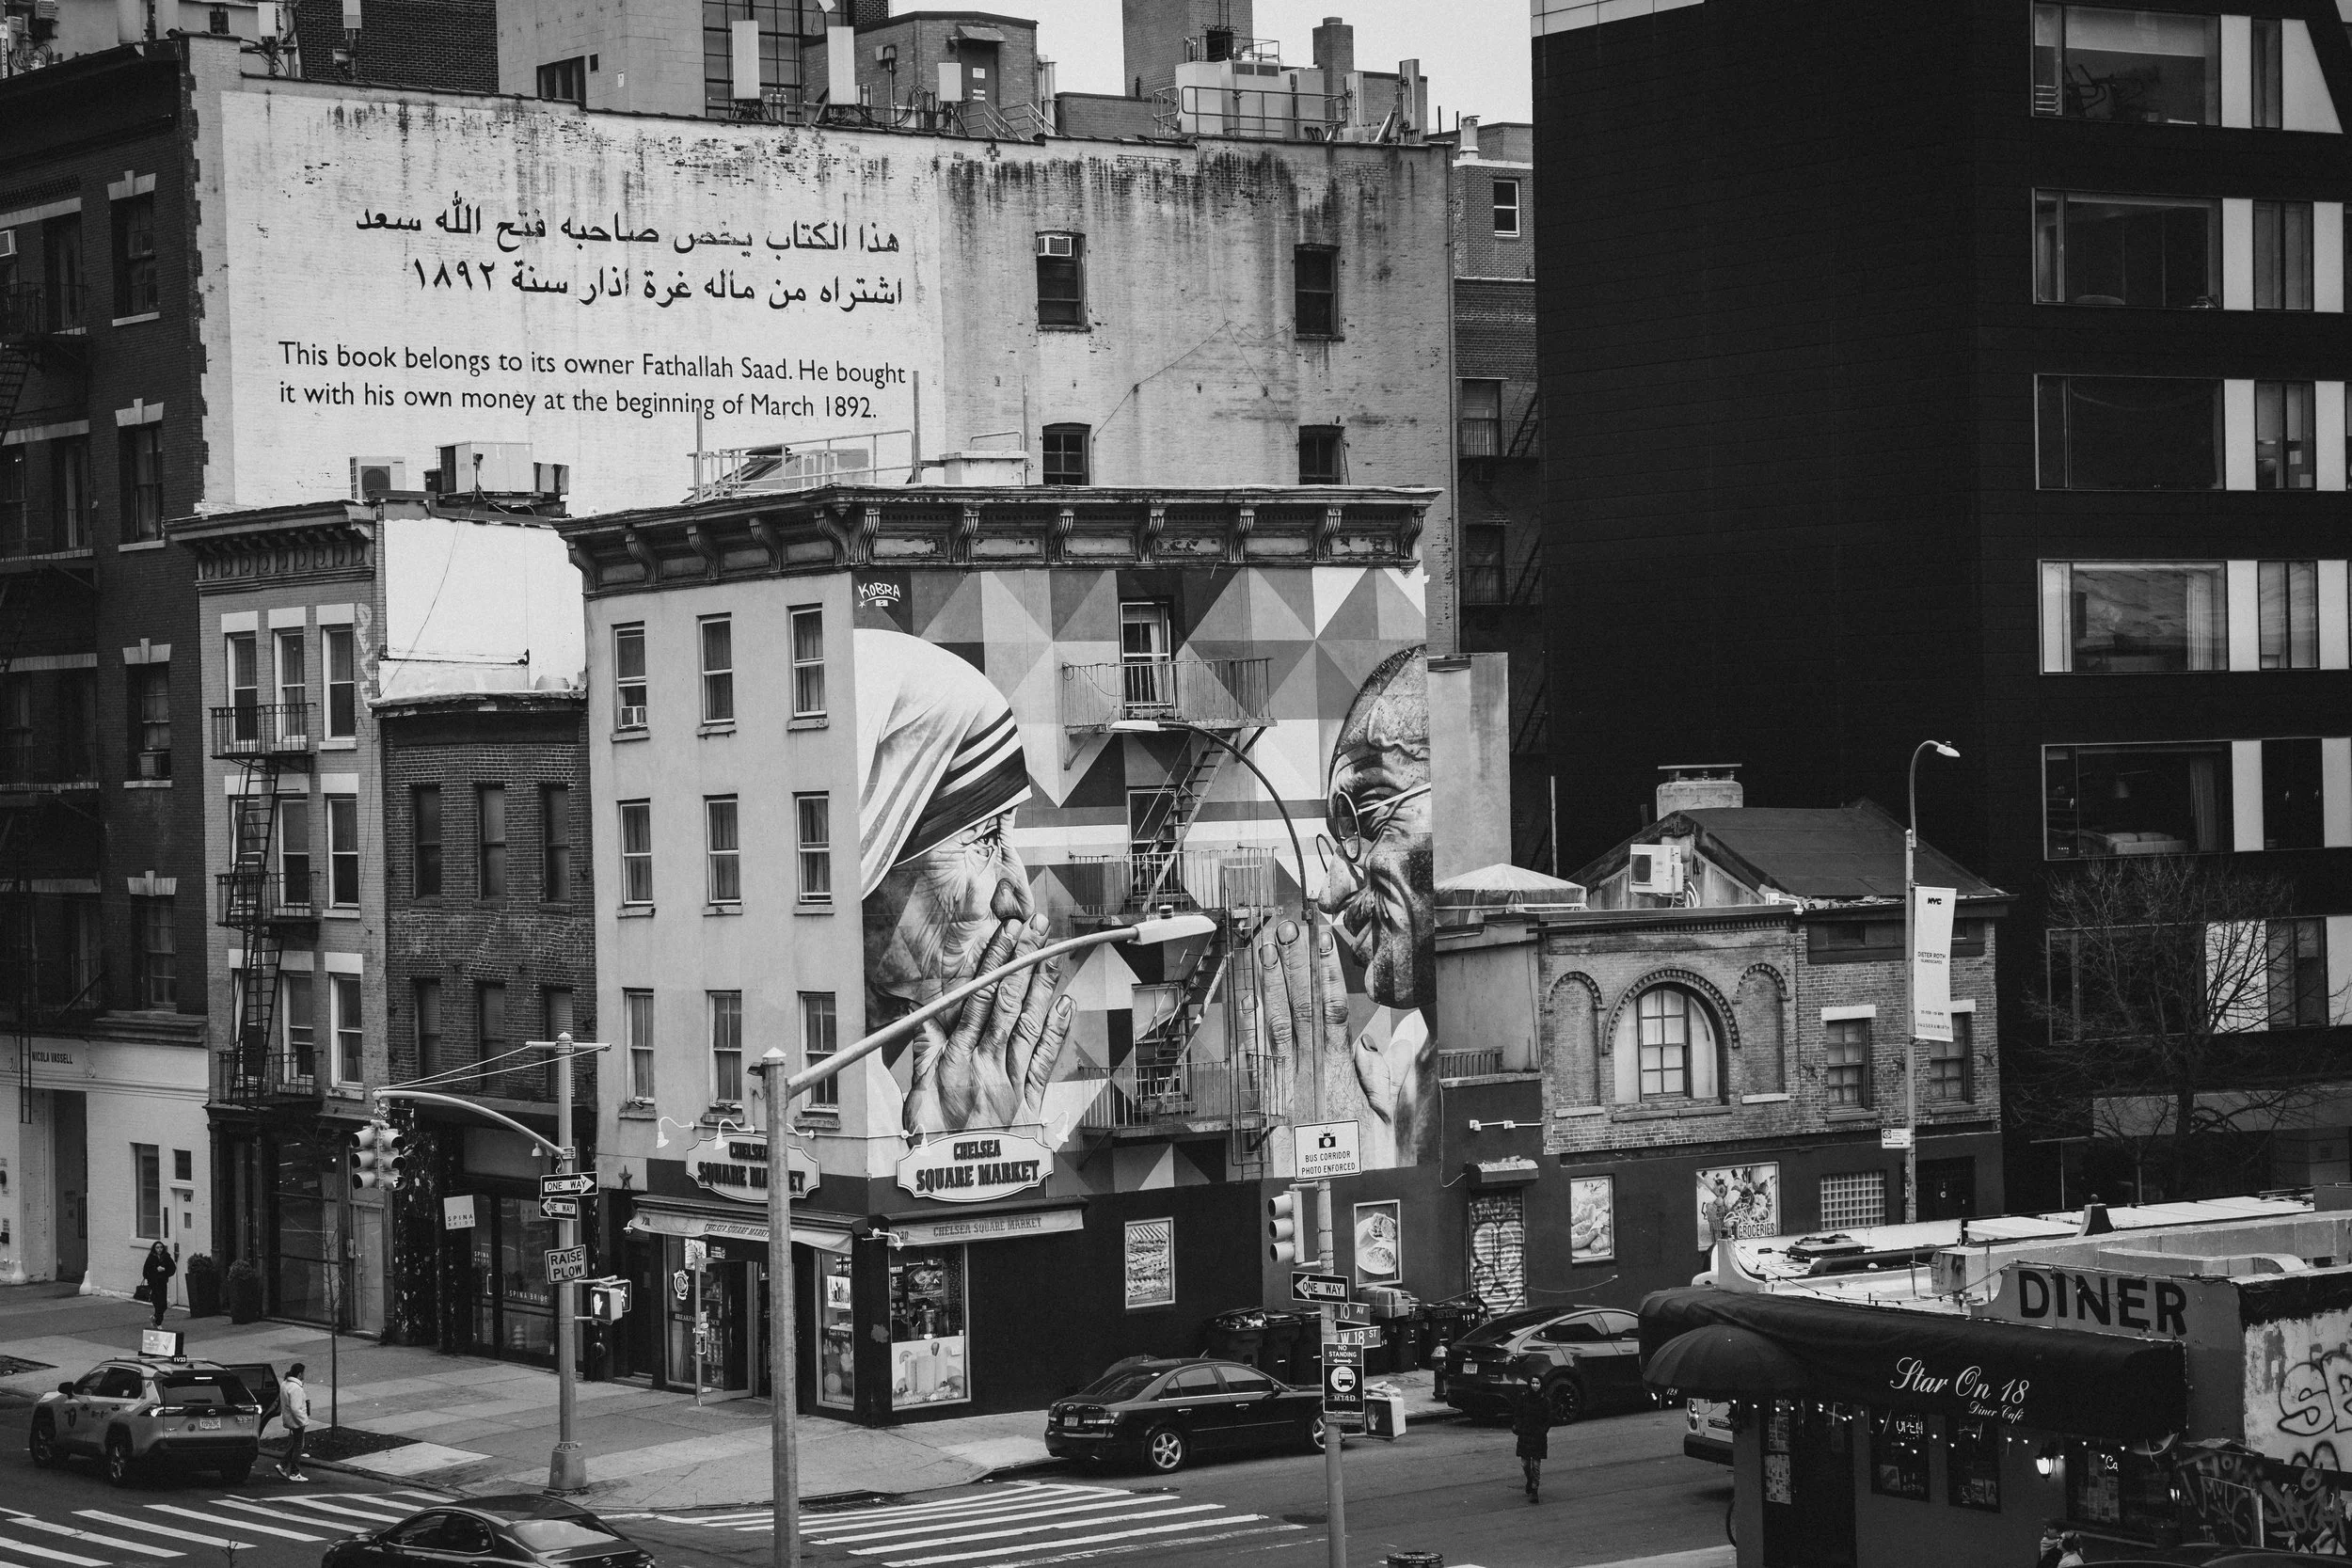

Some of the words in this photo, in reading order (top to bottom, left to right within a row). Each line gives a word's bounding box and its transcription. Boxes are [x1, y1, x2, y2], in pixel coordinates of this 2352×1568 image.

[357, 209, 421, 231] سعد
[497, 209, 547, 252] فتح
[561, 212, 660, 250] صاحبه
[766, 219, 847, 261] الكتاب
[860, 222, 899, 252] هذا
[413, 258, 495, 291] ١٨٩٢
[512, 260, 568, 294] سنة
[579, 265, 628, 305] اذار
[704, 269, 755, 299] ماله
[644, 270, 692, 308] غرة
[769, 279, 807, 309] من
[819, 276, 901, 312] اشتراه
[278, 341, 328, 366] This
[337, 343, 397, 368] book
[405, 346, 490, 376] belongs
[499, 354, 523, 372] to
[531, 351, 556, 372] its
[564, 357, 635, 374] owner
[643, 353, 734, 377] Fathallah
[741, 356, 793, 380] Saad.
[799, 358, 829, 381] He
[836, 360, 906, 389] bought
[279, 381, 296, 404] it
[304, 382, 354, 405] with
[365, 383, 394, 406] his
[404, 390, 453, 407] own
[462, 391, 536, 416] money
[544, 391, 565, 410] at
[573, 388, 608, 411] the
[616, 390, 715, 420] beginning
[723, 393, 745, 415] of
[752, 393, 814, 417] March
[825, 396, 878, 419] 1892.
[858, 582, 901, 599] KOBRA
[31, 1051, 50, 1063] NICOLA
[51, 1053, 73, 1064] VASSELL
[953, 1139, 1002, 1160] CHELSEA
[1305, 1153, 1318, 1163] BUS
[1319, 1150, 1351, 1162] CORRIDOR
[697, 1161, 747, 1187] SQUARE
[749, 1165, 806, 1193] MAET
[915, 1164, 975, 1193] SQUARE
[977, 1159, 1041, 1187] MARKET
[1301, 1165, 1322, 1175] PHOTO
[1323, 1163, 1356, 1174] ENFORCED
[547, 1181, 563, 1191] ONE
[570, 1180, 587, 1189] WAY
[447, 1213, 474, 1223] SPINA
[546, 1202, 557, 1212] ONE
[562, 1204, 574, 1212] WAY
[705, 1223, 727, 1232] CHELSEA
[727, 1225, 749, 1235] SQUARE
[749, 1227, 770, 1237] MARKE
[933, 1224, 971, 1237] CHELSEA
[974, 1221, 1006, 1233] SQUARE
[1008, 1217, 1042, 1230] MARKET
[1738, 1223, 1775, 1238] GROCERIES
[550, 1250, 583, 1265] RAISE
[553, 1264, 582, 1280] PLOW
[509, 1290, 528, 1299] SPINA
[1302, 1281, 1318, 1292] ONE
[1325, 1284, 1343, 1295] WAY
[1340, 1304, 1350, 1320] 10
[1356, 1306, 1364, 1315] AV
[2018, 1270, 2187, 1337] DINER
[1341, 1332, 1350, 1344] W
[1354, 1331, 1364, 1344] 18
[1368, 1329, 1377, 1338] ST
[1889, 1356, 1948, 1393] Star
[1955, 1365, 1991, 1400] On
[2000, 1378, 2029, 1404] 18
[1666, 1387, 1678, 1396] 128
[1968, 1401, 1997, 1418] Diner
[2001, 1404, 2025, 1424] Café
